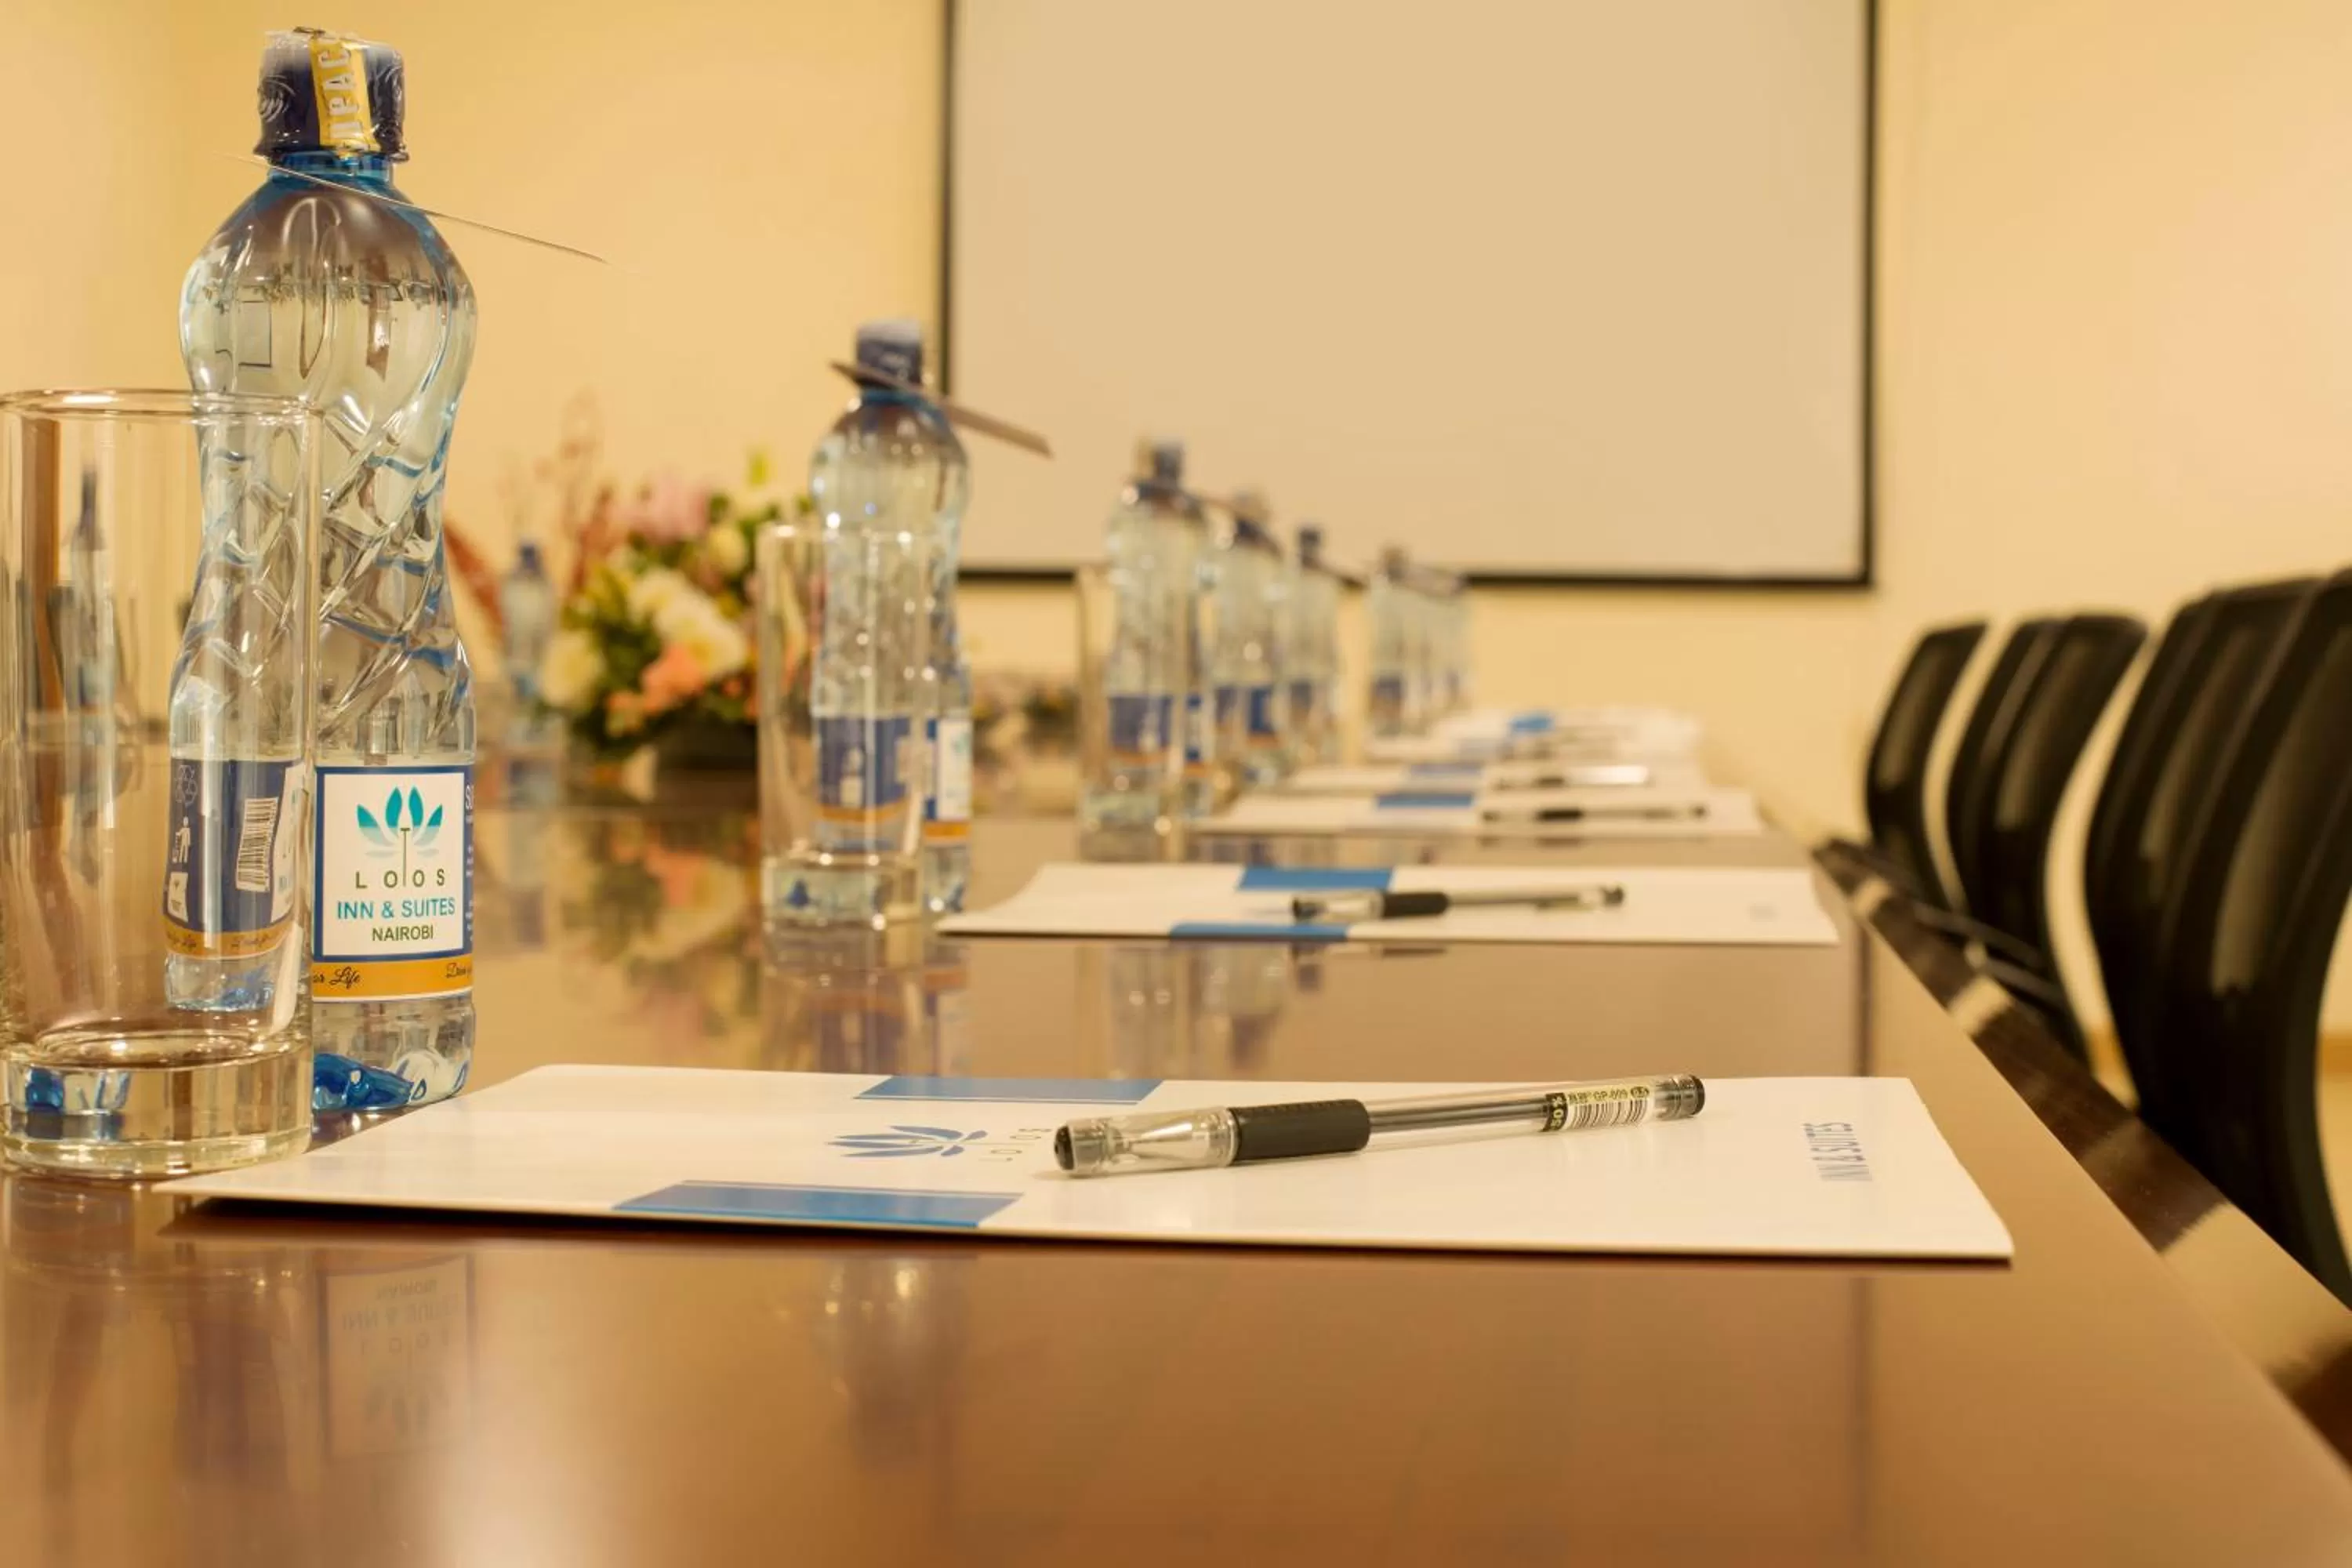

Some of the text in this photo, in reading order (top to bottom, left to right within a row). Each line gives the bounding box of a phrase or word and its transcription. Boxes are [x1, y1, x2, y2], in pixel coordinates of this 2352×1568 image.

[337, 898, 456, 920] INN & SUITES
[372, 924, 434, 942] NAIROBI
[1801, 1122, 1861, 1152] SUITES
